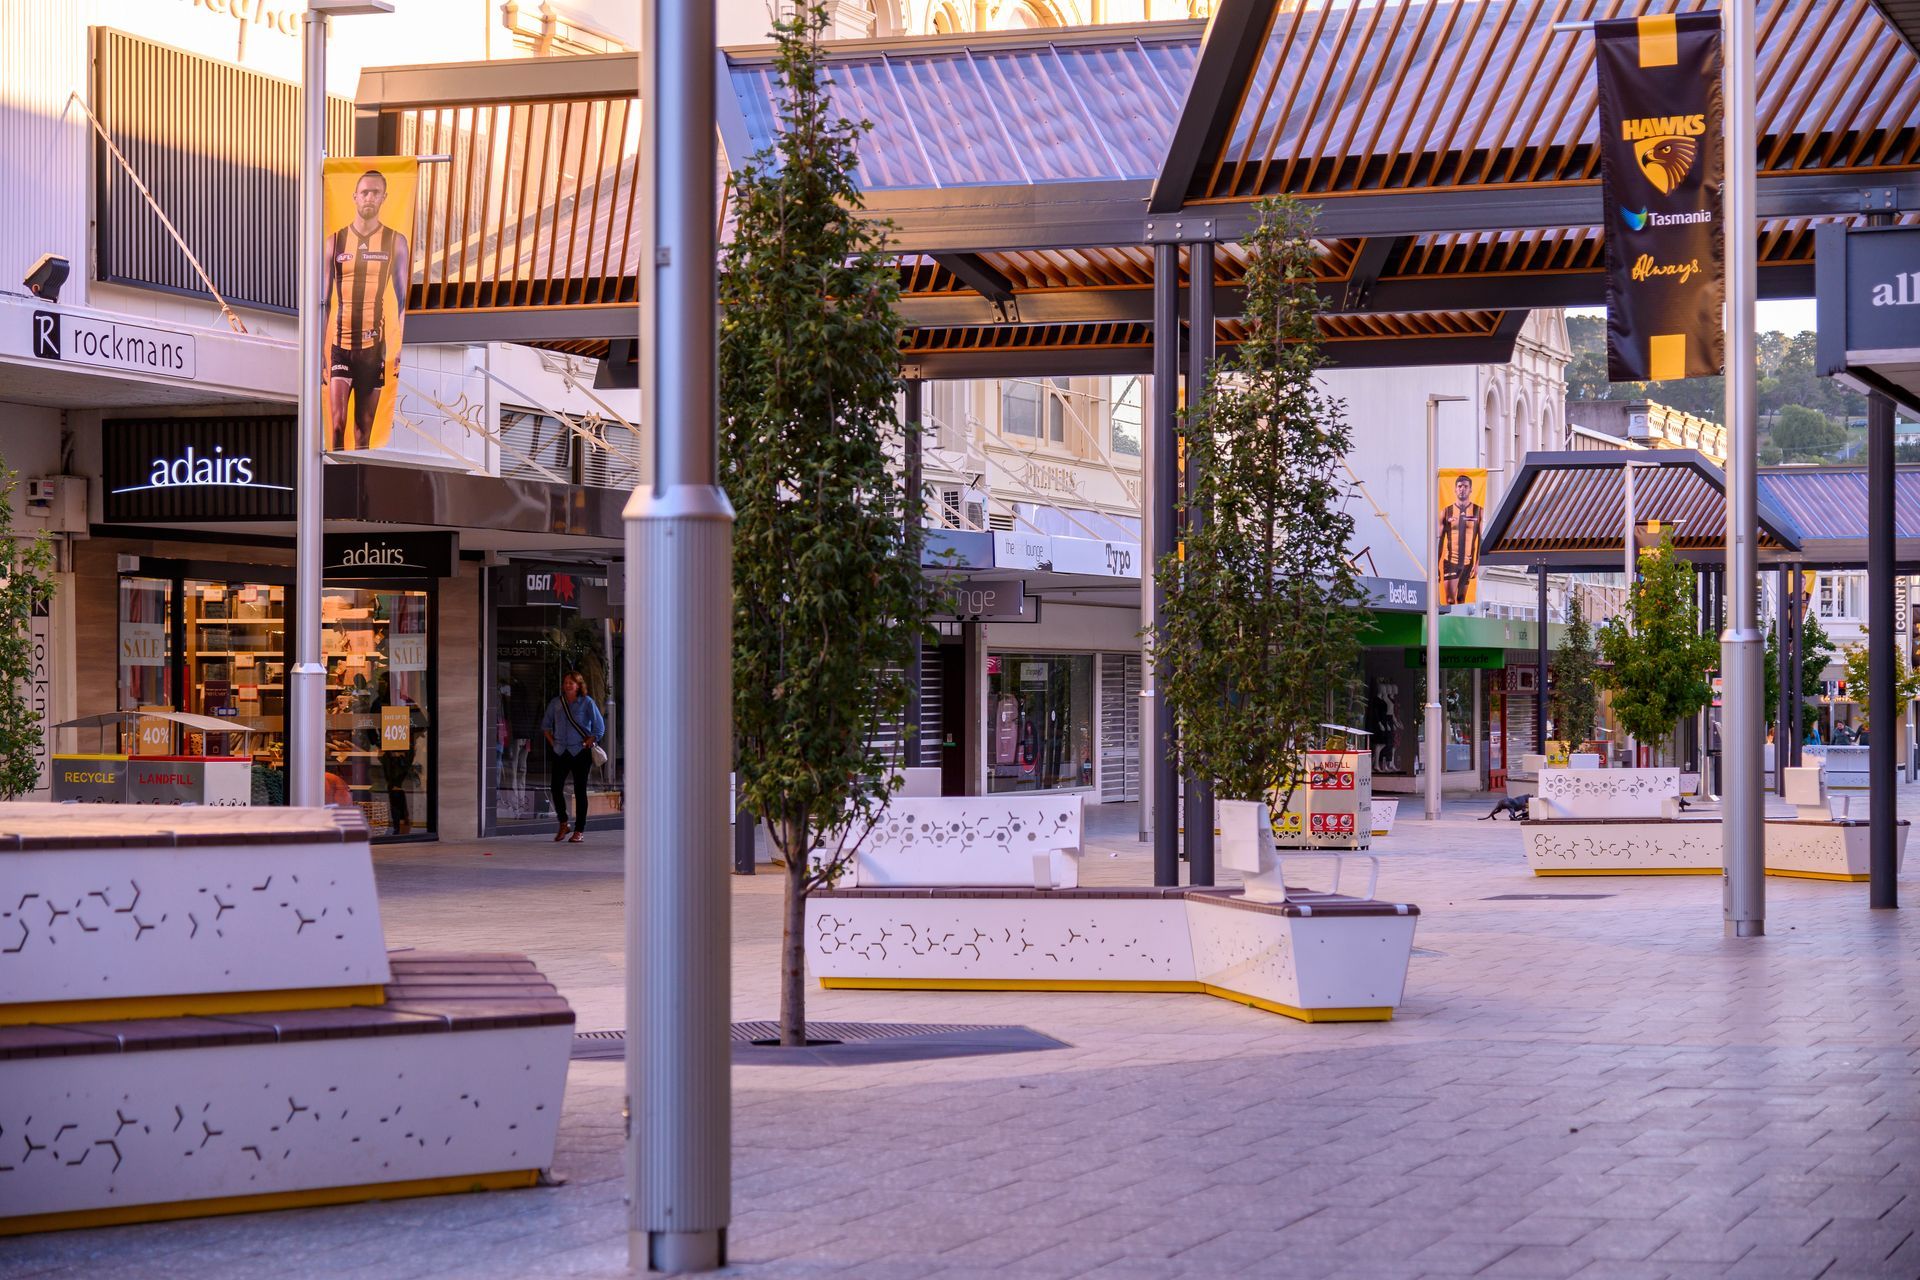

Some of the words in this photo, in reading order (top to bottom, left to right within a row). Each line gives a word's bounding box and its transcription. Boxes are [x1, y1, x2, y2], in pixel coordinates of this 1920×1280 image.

[1622, 114, 1706, 141] HAWKS
[1649, 209, 1712, 226] Tasmania
[35, 315, 59, 354] R
[74, 325, 184, 369] rockmans
[150, 446, 253, 487] adairs
[342, 542, 404, 567] adairs
[1105, 543, 1131, 575] Typo
[1389, 581, 1418, 605] Best&Less
[123, 639, 161, 659] SALE
[393, 647, 424, 665] SALE
[64, 771, 116, 784] RECYCLE
[139, 773, 193, 785] LANDFILL
